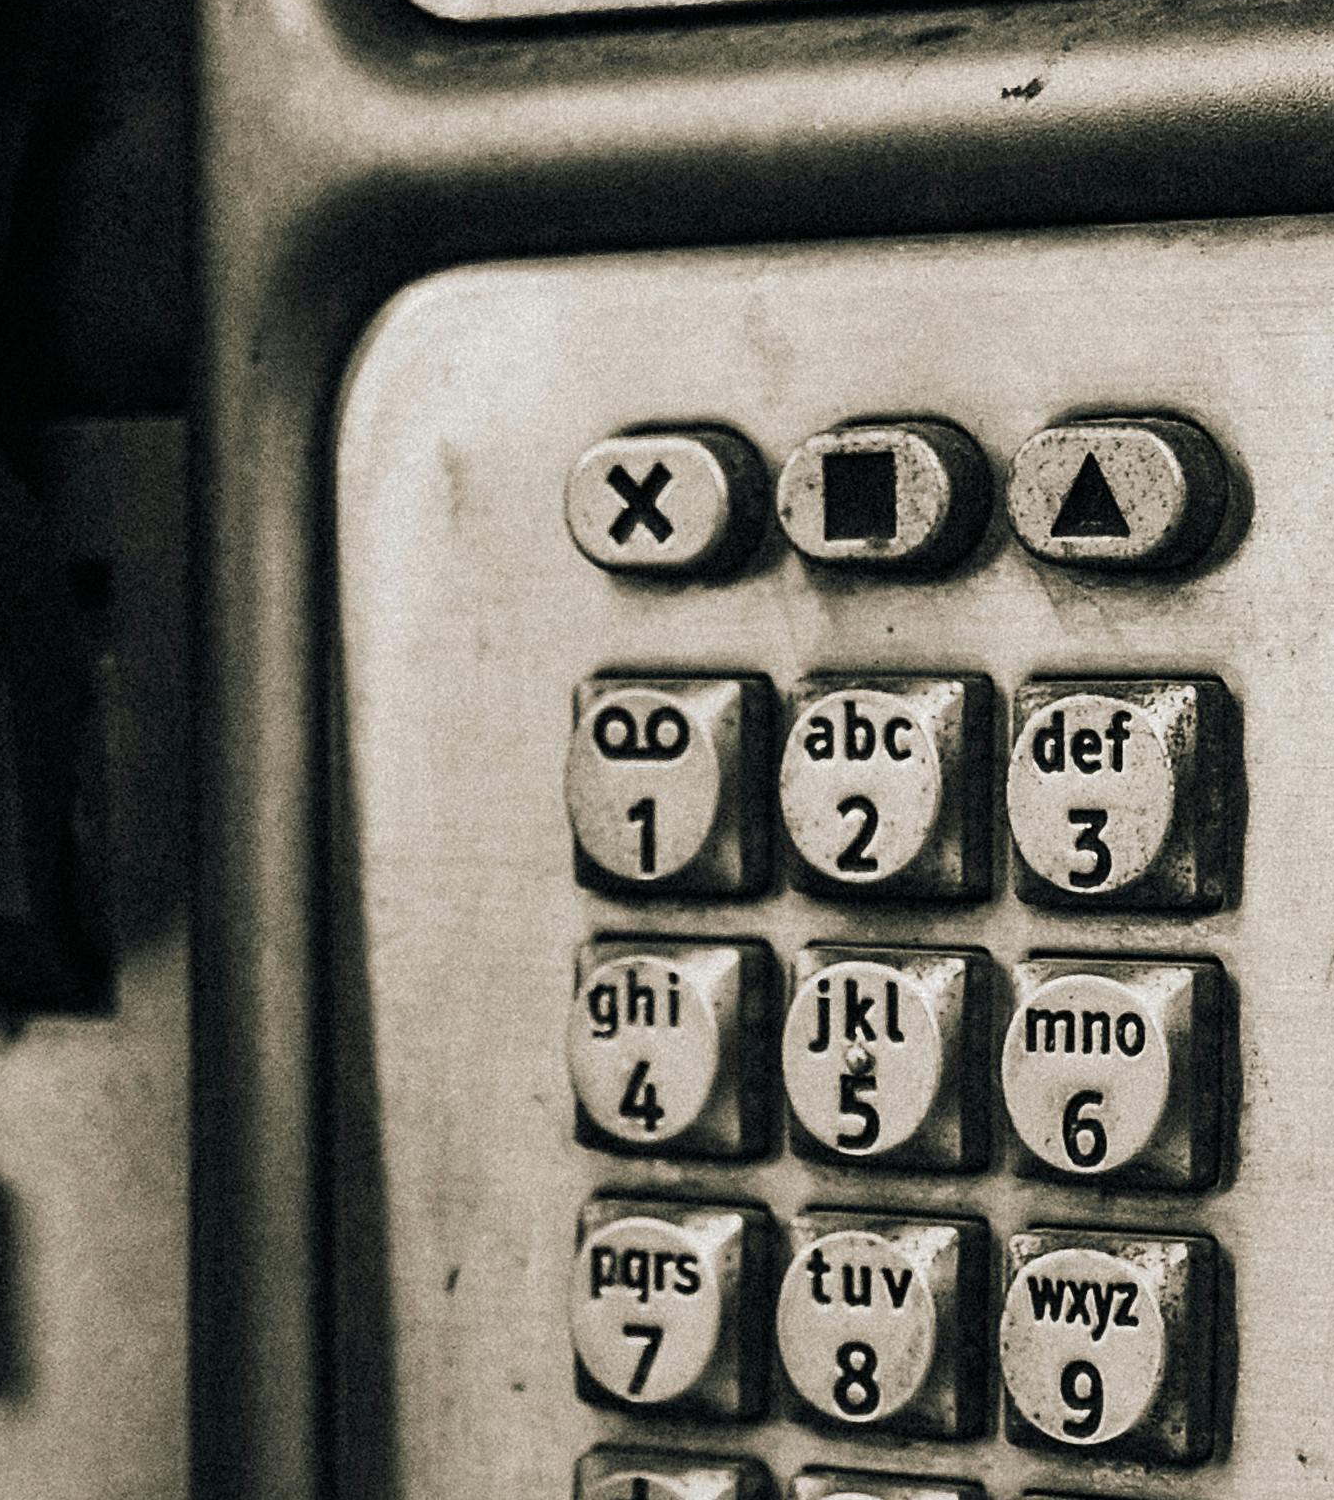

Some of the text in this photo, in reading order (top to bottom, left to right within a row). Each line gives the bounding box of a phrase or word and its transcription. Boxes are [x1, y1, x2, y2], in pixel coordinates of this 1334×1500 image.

[804, 701, 912, 761] abc
[1033, 711, 1132, 774] def
[628, 798, 655, 873] 1
[837, 796, 879, 871] 2
[1068, 808, 1111, 888] 3
[588, 970, 680, 1039] ghi
[808, 979, 905, 1052] jkl
[1025, 1007, 1146, 1057] mno
[620, 1061, 664, 1132] 4
[837, 1074, 880, 1149] 5
[1062, 1090, 1107, 1168] 6
[590, 1245, 701, 1302] pqrs
[807, 1248, 913, 1308] tuv
[1028, 1276, 1139, 1341] wxyz
[623, 1325, 664, 1394] 7
[833, 1342, 880, 1415] 8
[1060, 1360, 1104, 1437] 9
